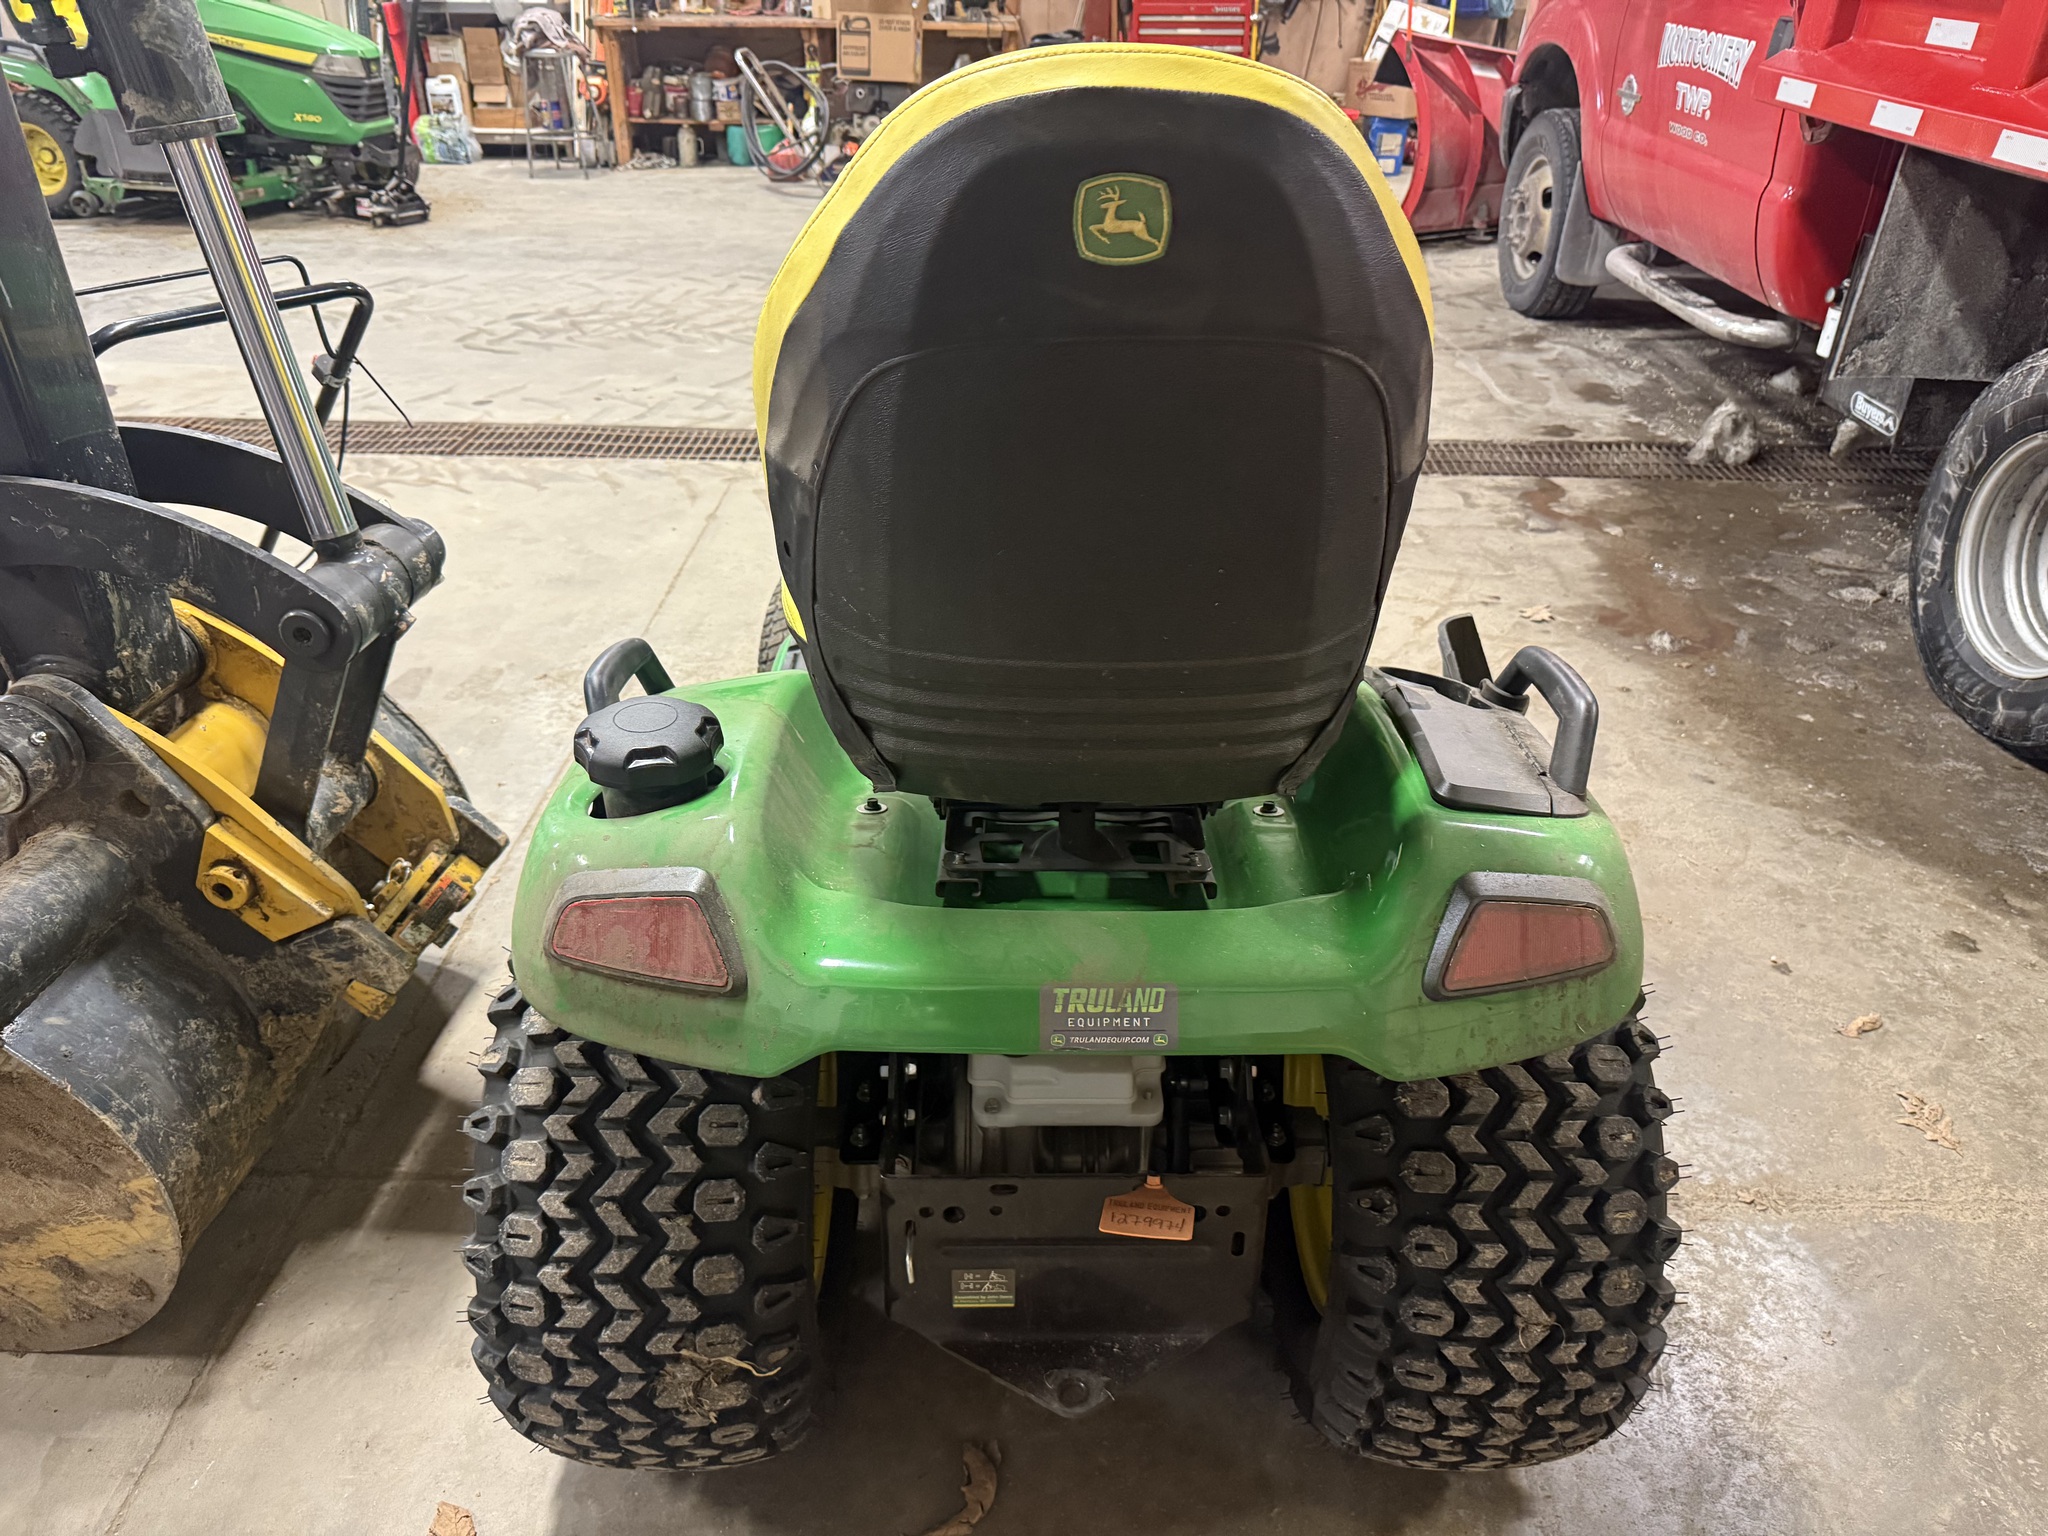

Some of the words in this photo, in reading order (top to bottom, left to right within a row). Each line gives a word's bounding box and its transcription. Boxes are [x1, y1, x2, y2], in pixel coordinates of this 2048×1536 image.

[1657, 22, 1757, 90] MONTGOMERY
[1675, 81, 1712, 121] TWP.
[1854, 395, 1886, 424] Buyers
[1053, 987, 1166, 1013] TRULAND
[1067, 1017, 1151, 1027] EQUIPMENT
[1069, 1036, 1150, 1044] TRULANDEQUIP.COM
[1147, 1203, 1191, 1214] EQUIPMENT
[1110, 1212, 1186, 1232] 1279974
